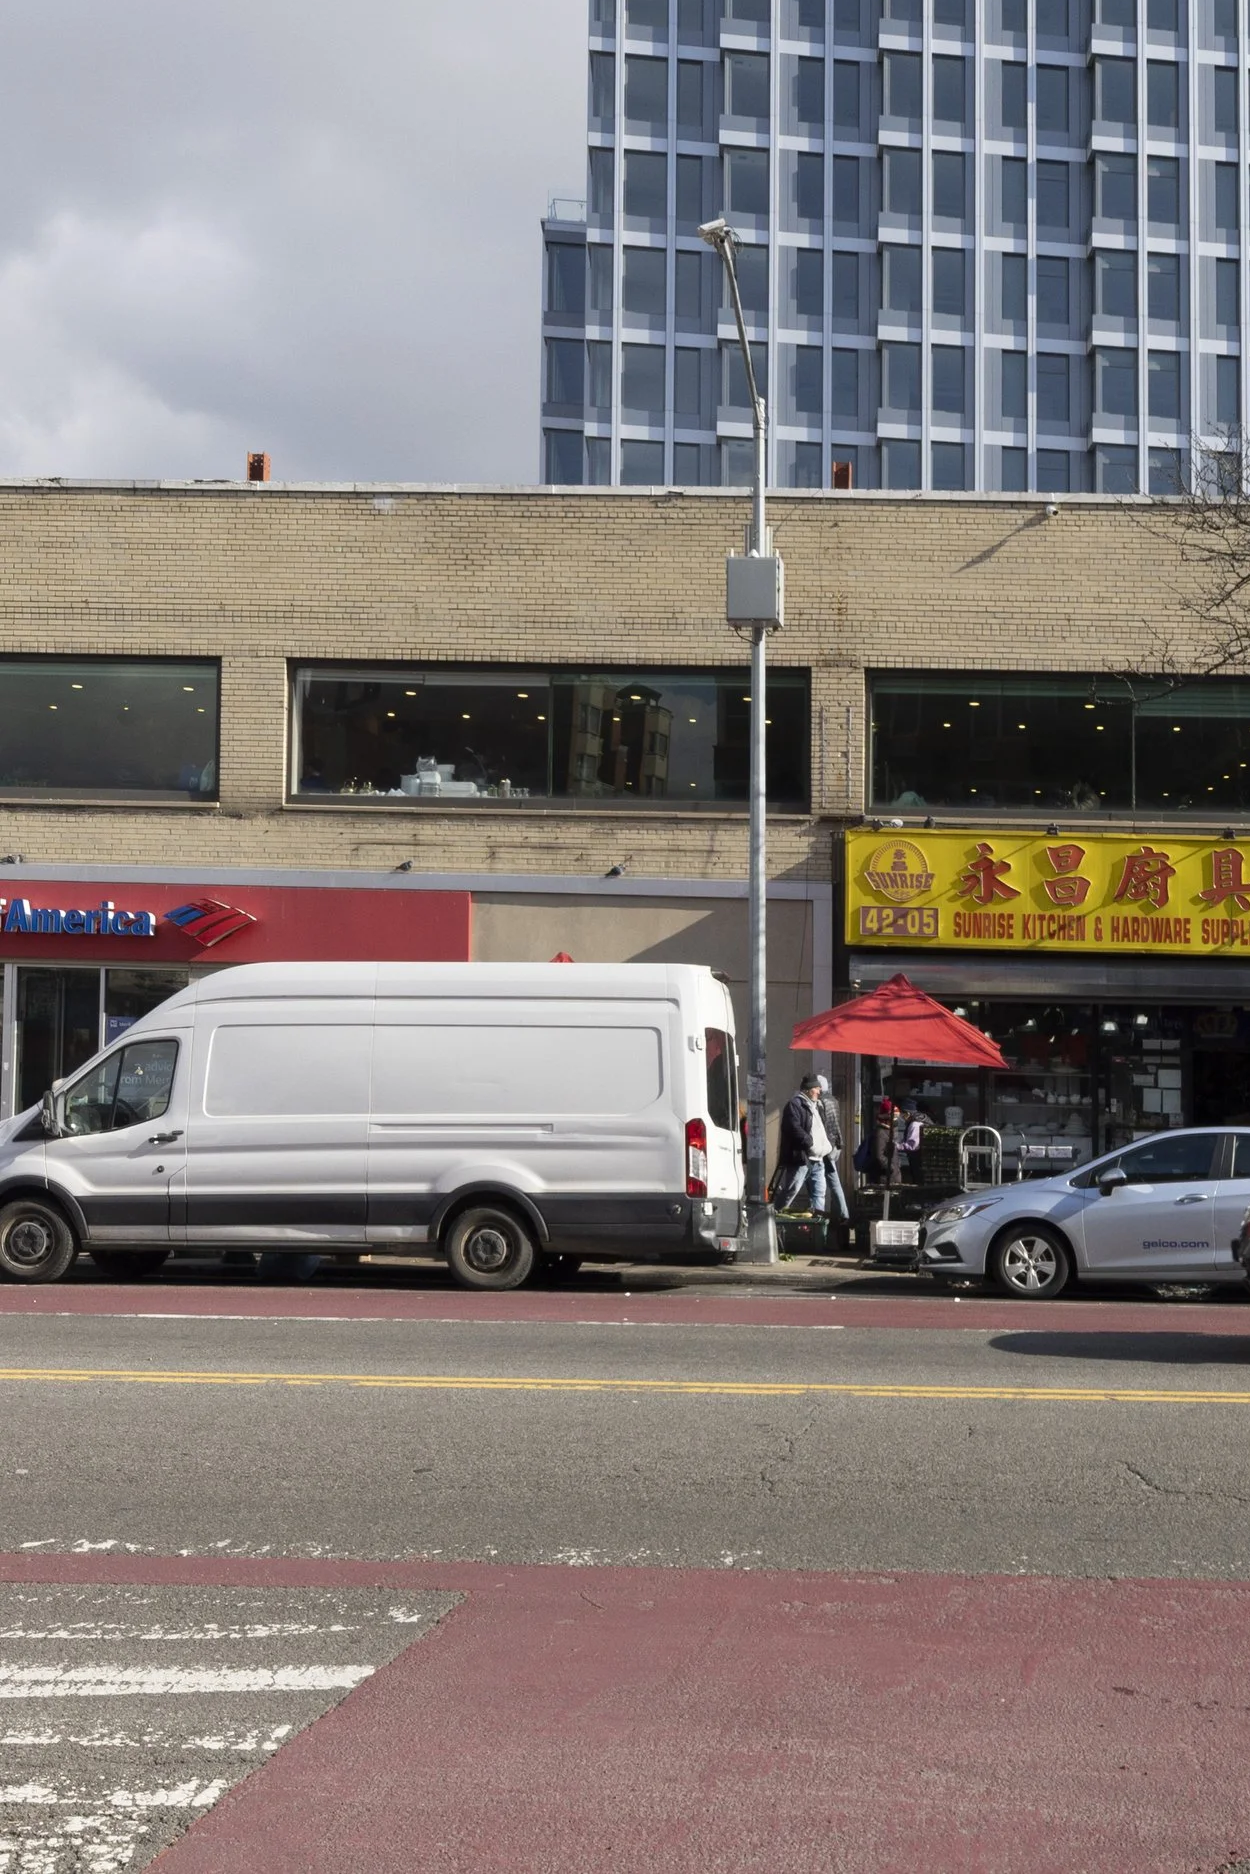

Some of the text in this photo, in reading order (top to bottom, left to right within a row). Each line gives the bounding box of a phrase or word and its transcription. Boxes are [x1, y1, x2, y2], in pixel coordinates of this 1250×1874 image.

[864, 871, 935, 889] SUNRISE
[4, 898, 156, 937] America
[865, 908, 935, 934] 42-05
[953, 911, 1015, 940] SUNRISE
[1022, 913, 1086, 942] KITCHEN
[1093, 916, 1104, 943] &
[1110, 916, 1192, 945] HARDWARE
[1142, 1239, 1209, 1249] geico.com
